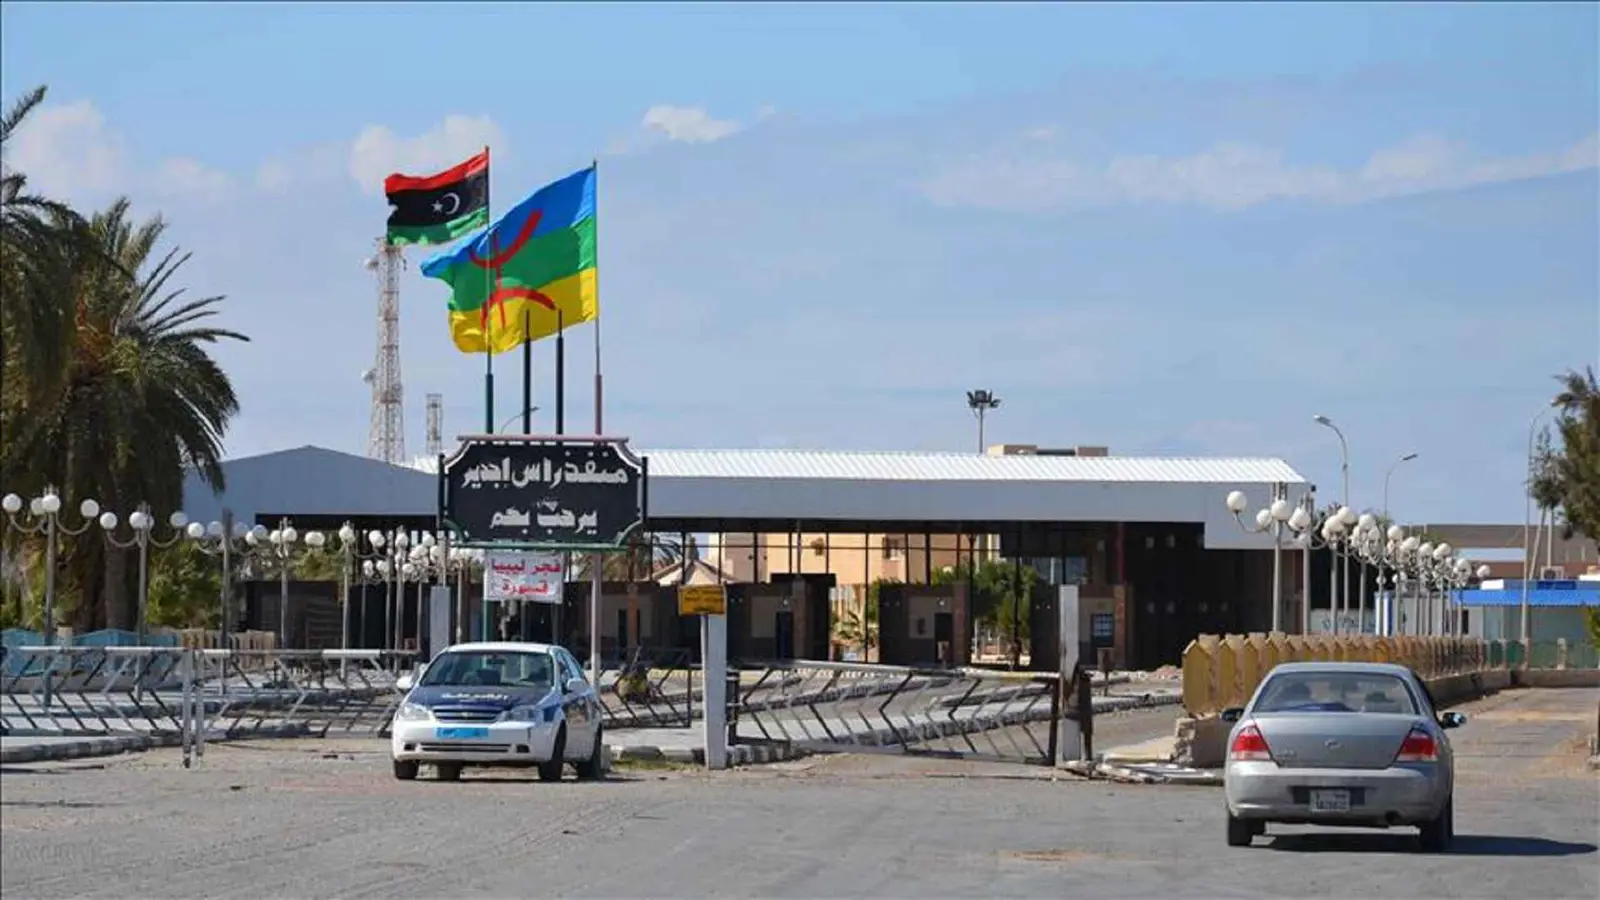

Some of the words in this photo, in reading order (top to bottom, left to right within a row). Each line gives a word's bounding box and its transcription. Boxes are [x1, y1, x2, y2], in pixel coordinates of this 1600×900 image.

[564, 451, 629, 484] منفذ
[489, 507, 530, 535] بكم
[537, 508, 598, 535] يرحب
